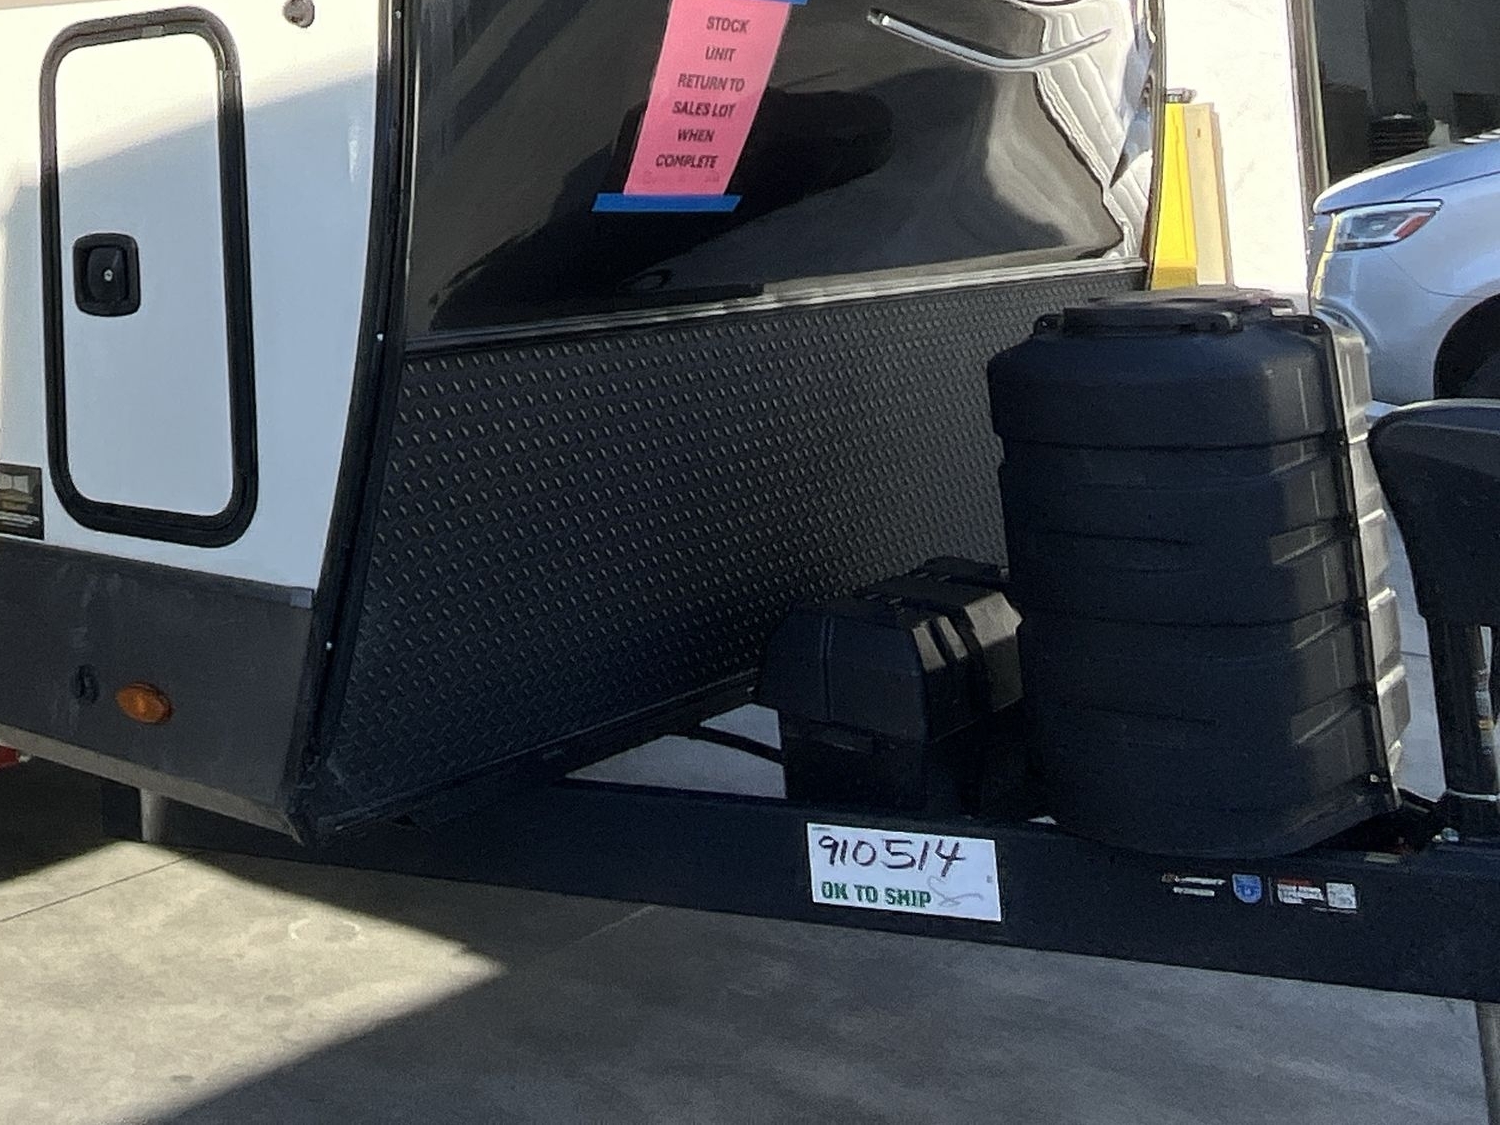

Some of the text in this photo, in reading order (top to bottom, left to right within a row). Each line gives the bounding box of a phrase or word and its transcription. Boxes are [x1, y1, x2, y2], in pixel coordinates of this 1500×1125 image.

[706, 15, 750, 33] STOCK
[705, 45, 737, 62] UNIT
[678, 73, 745, 93] RETURN TO
[672, 101, 736, 118] SALES LOT
[677, 129, 715, 143] WHEN
[655, 154, 719, 169] COMPLETE
[818, 835, 966, 878] 910514
[821, 881, 932, 909] OK TO SHIP
